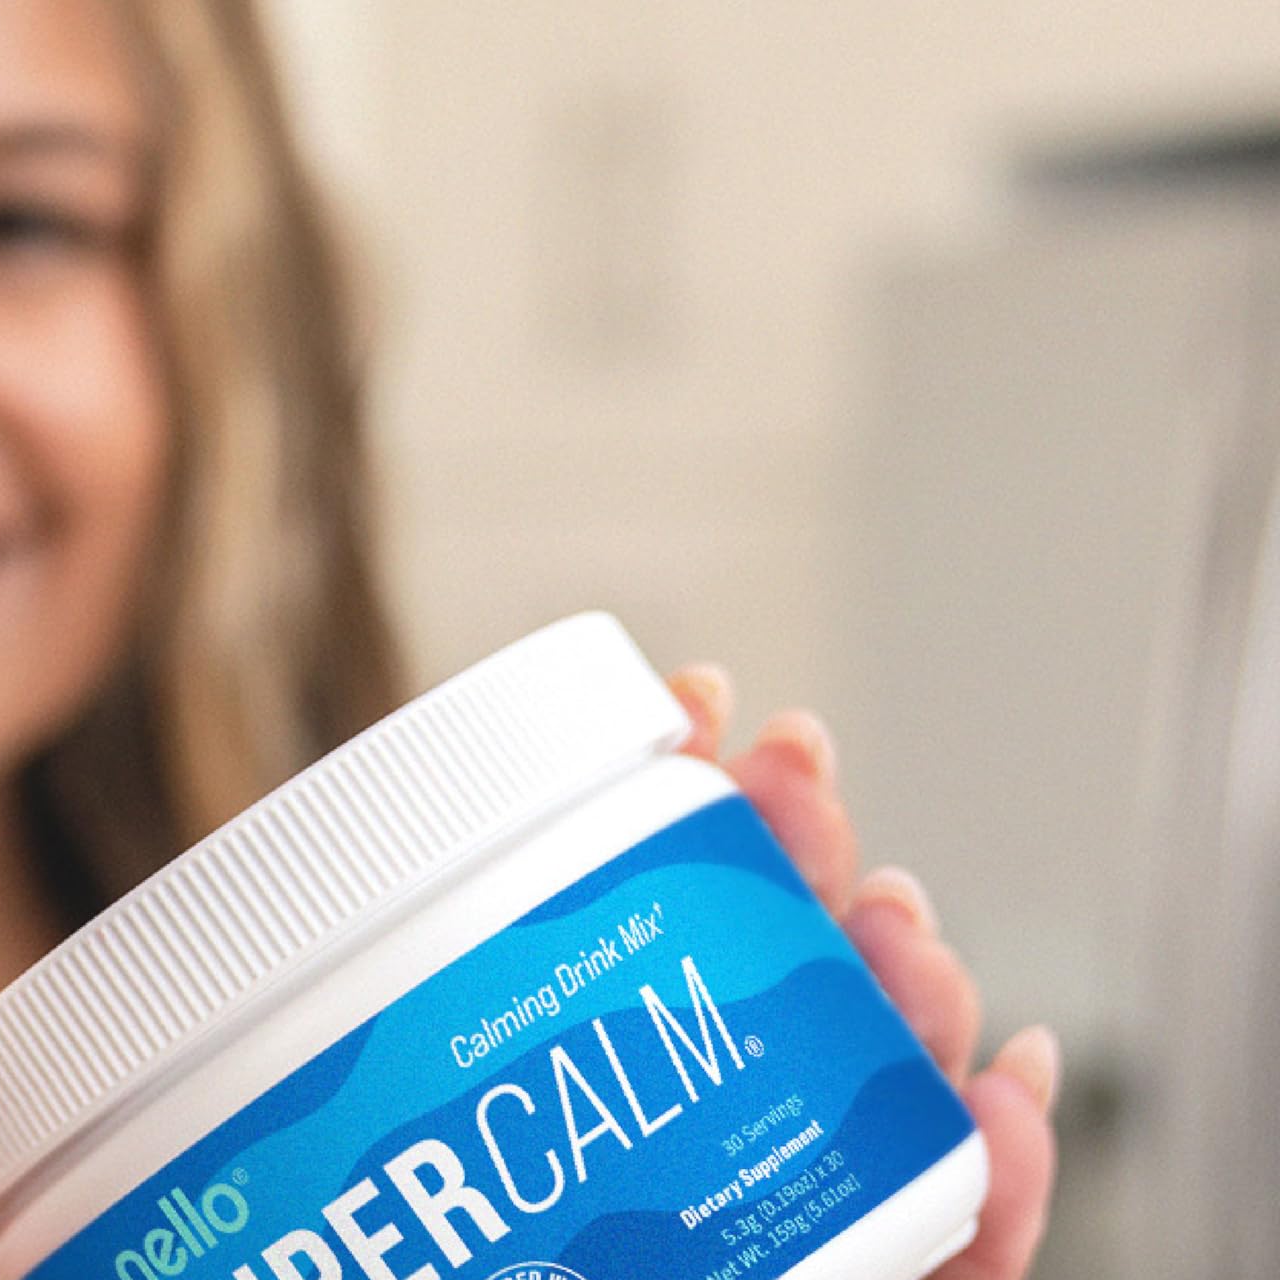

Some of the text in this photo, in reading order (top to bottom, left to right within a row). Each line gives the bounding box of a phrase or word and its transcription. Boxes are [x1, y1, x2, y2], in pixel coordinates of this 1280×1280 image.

[450, 983, 560, 1068] Calming
[554, 937, 623, 998] Drink
[721, 1093, 804, 1157] 30 Servings
[679, 1119, 824, 1230] Dietary Supplement
[721, 1213, 763, 1246] 5.3g
[757, 1169, 817, 1222] (0.19oz)
[823, 1150, 844, 1173] 30
[737, 1243, 770, 1268] Wt.
[768, 1213, 811, 1248] 159g
[804, 1173, 861, 1221] (5.61oz)
